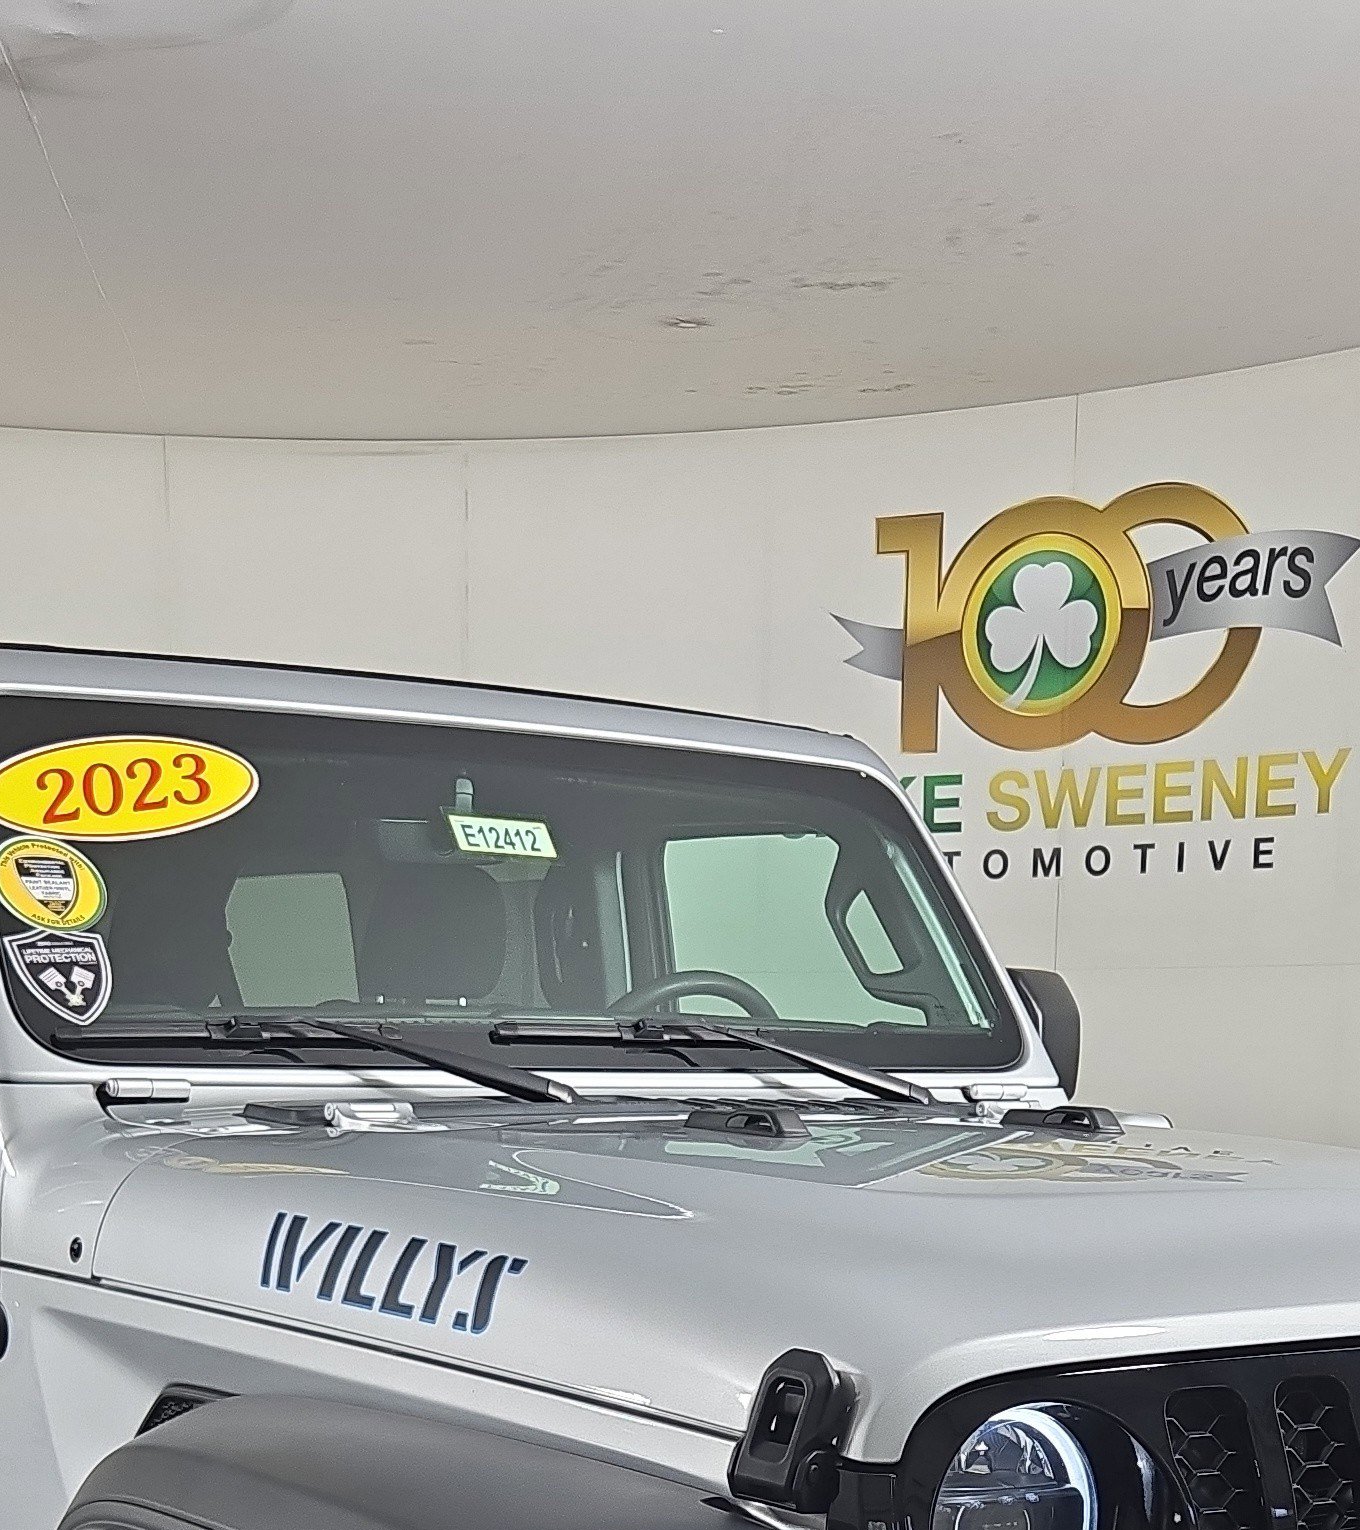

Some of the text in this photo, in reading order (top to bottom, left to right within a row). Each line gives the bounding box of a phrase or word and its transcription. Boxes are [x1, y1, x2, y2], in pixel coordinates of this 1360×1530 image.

[1163, 545, 1315, 627] years
[36, 753, 212, 824] 2023
[986, 747, 1352, 832] SWEENEY
[460, 824, 542, 852] E12412
[31, 913, 46, 923] ASK
[61, 914, 86, 926] DETAILS
[24, 952, 97, 964] PROTECTION
[260, 1211, 528, 1335] WILLYS
